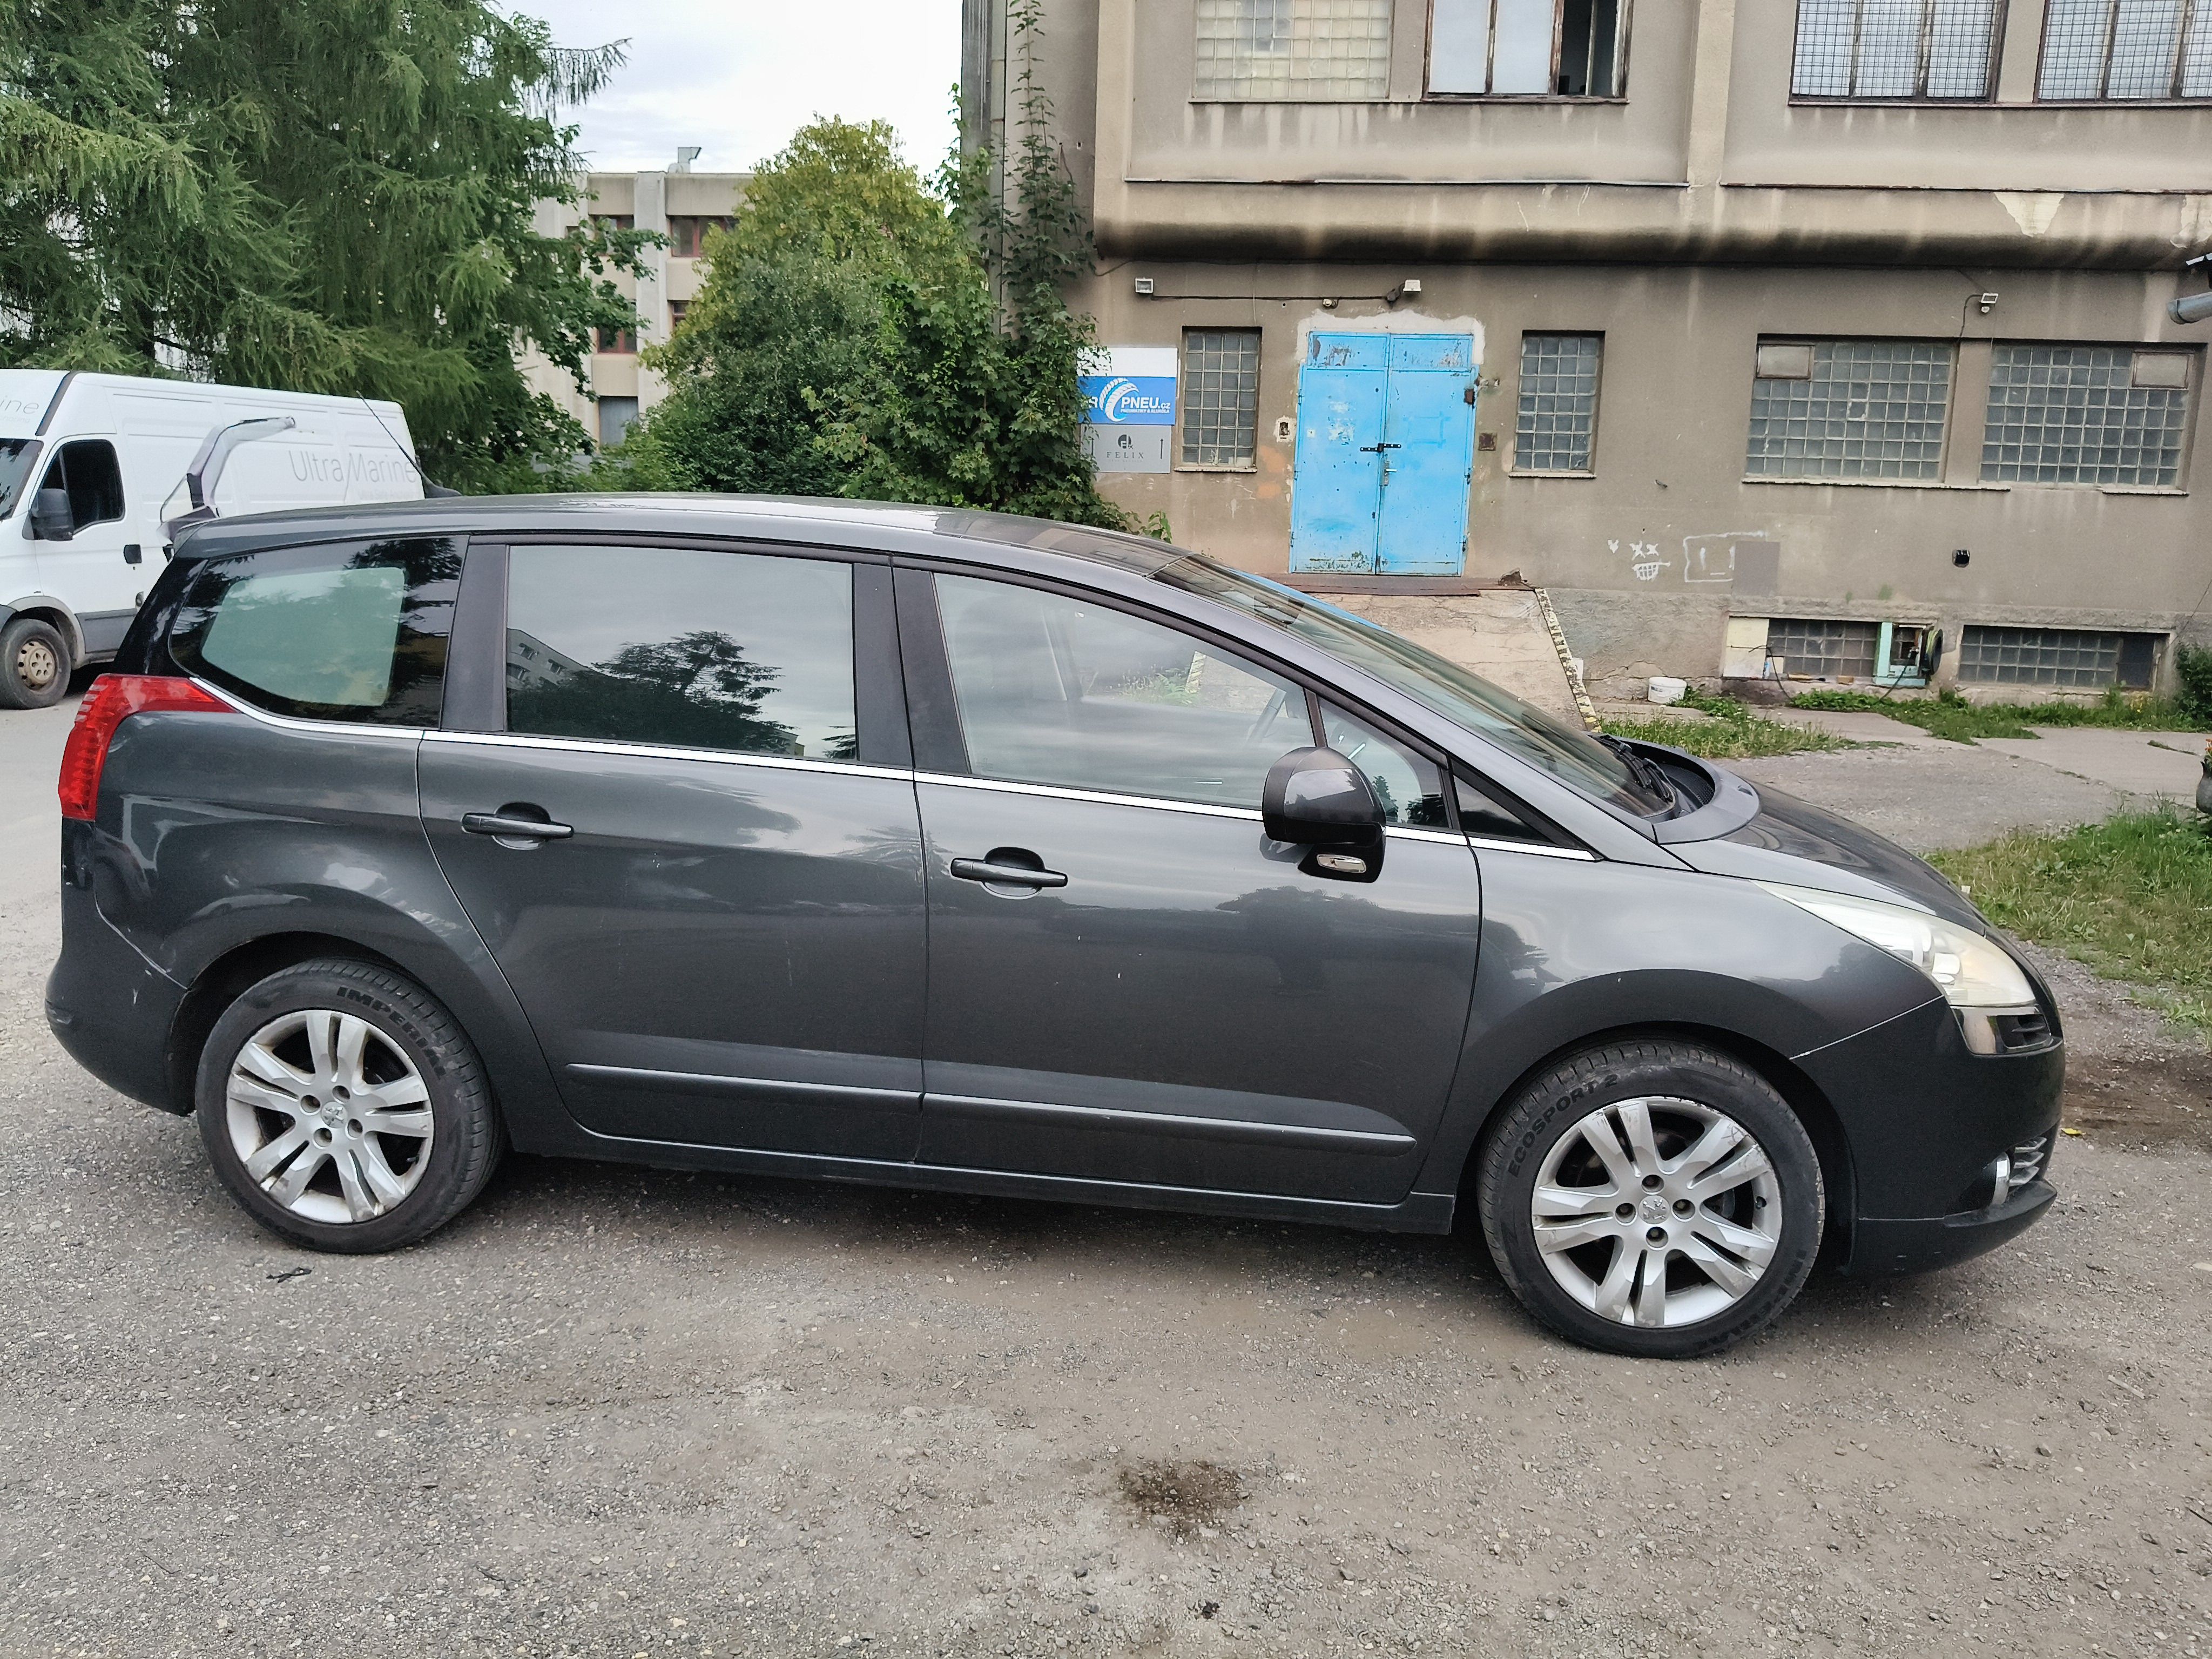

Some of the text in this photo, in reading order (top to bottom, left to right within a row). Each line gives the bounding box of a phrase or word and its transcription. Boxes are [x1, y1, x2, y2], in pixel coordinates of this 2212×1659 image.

[1121, 397, 1171, 409] PNEU.cz
[288, 450, 417, 483] Ultra Marine
[337, 986, 446, 1080] IMPERIAL
[1508, 1074, 1618, 1178] ECOSPORT 2
